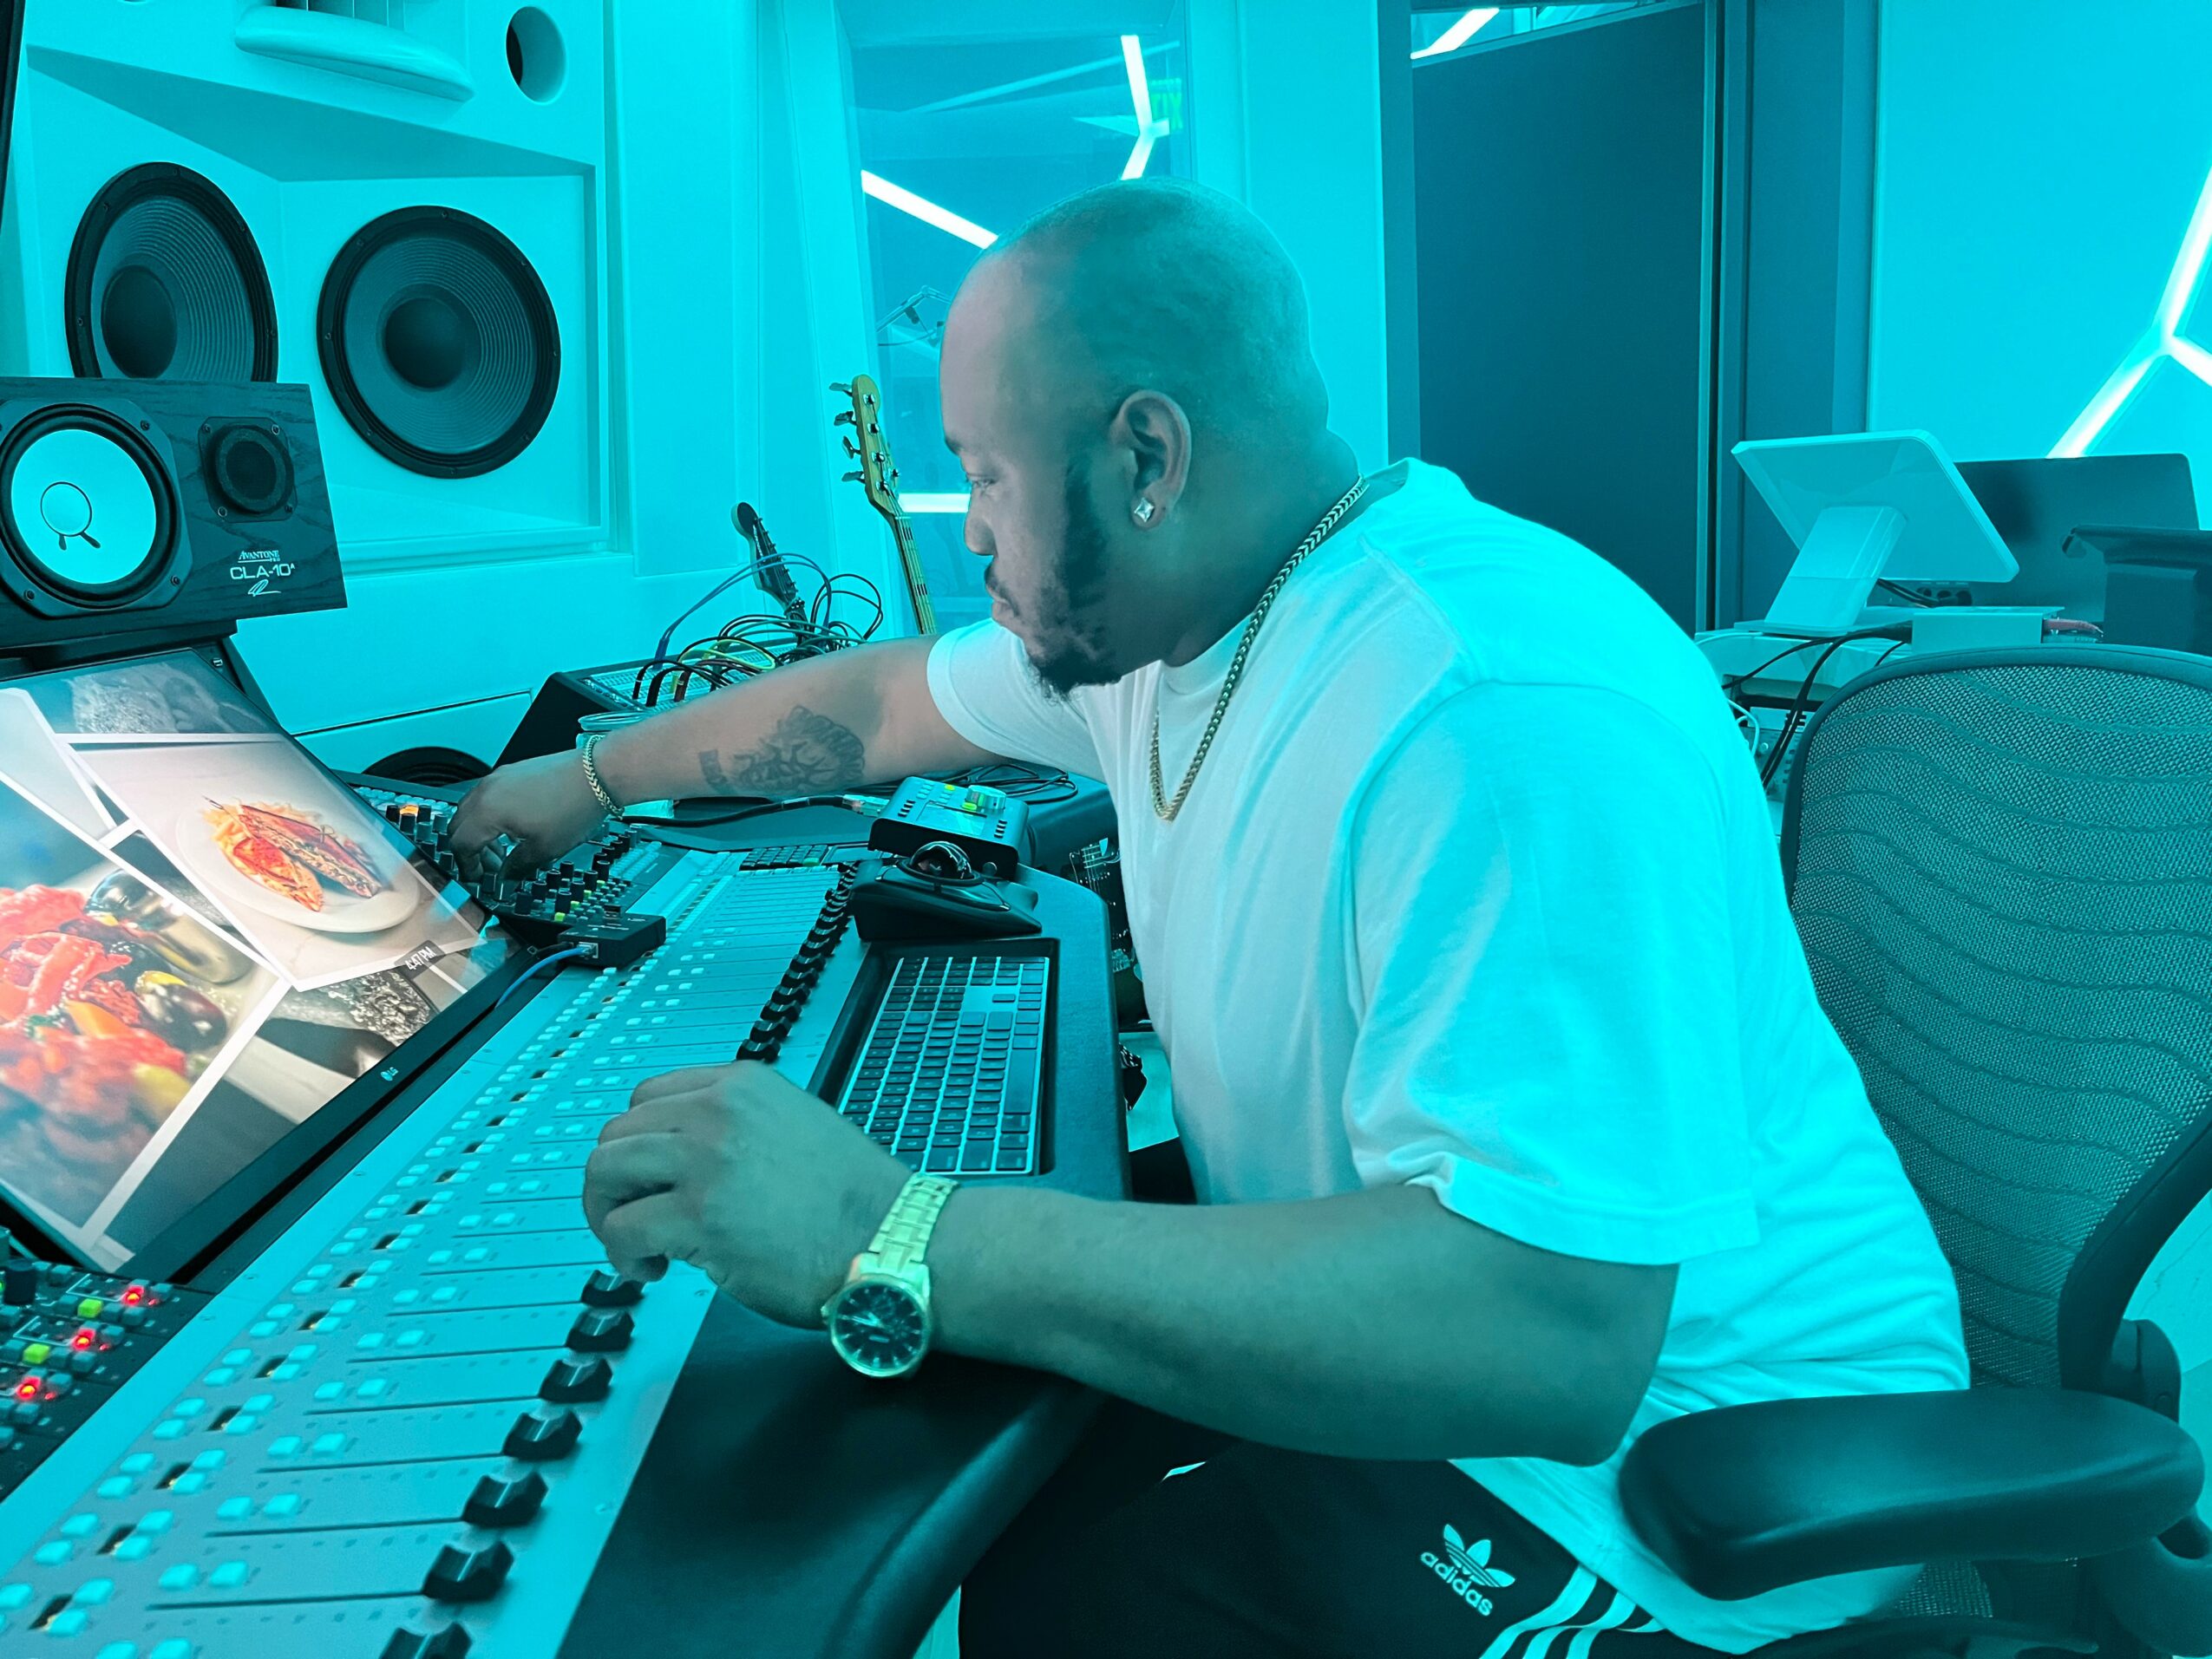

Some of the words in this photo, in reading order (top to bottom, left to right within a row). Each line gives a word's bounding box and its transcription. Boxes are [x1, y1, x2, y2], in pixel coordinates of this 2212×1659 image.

[239, 550, 280, 560] AVANTONE
[417, 946, 436, 961] PM
[1421, 1552, 1493, 1616] adidas
